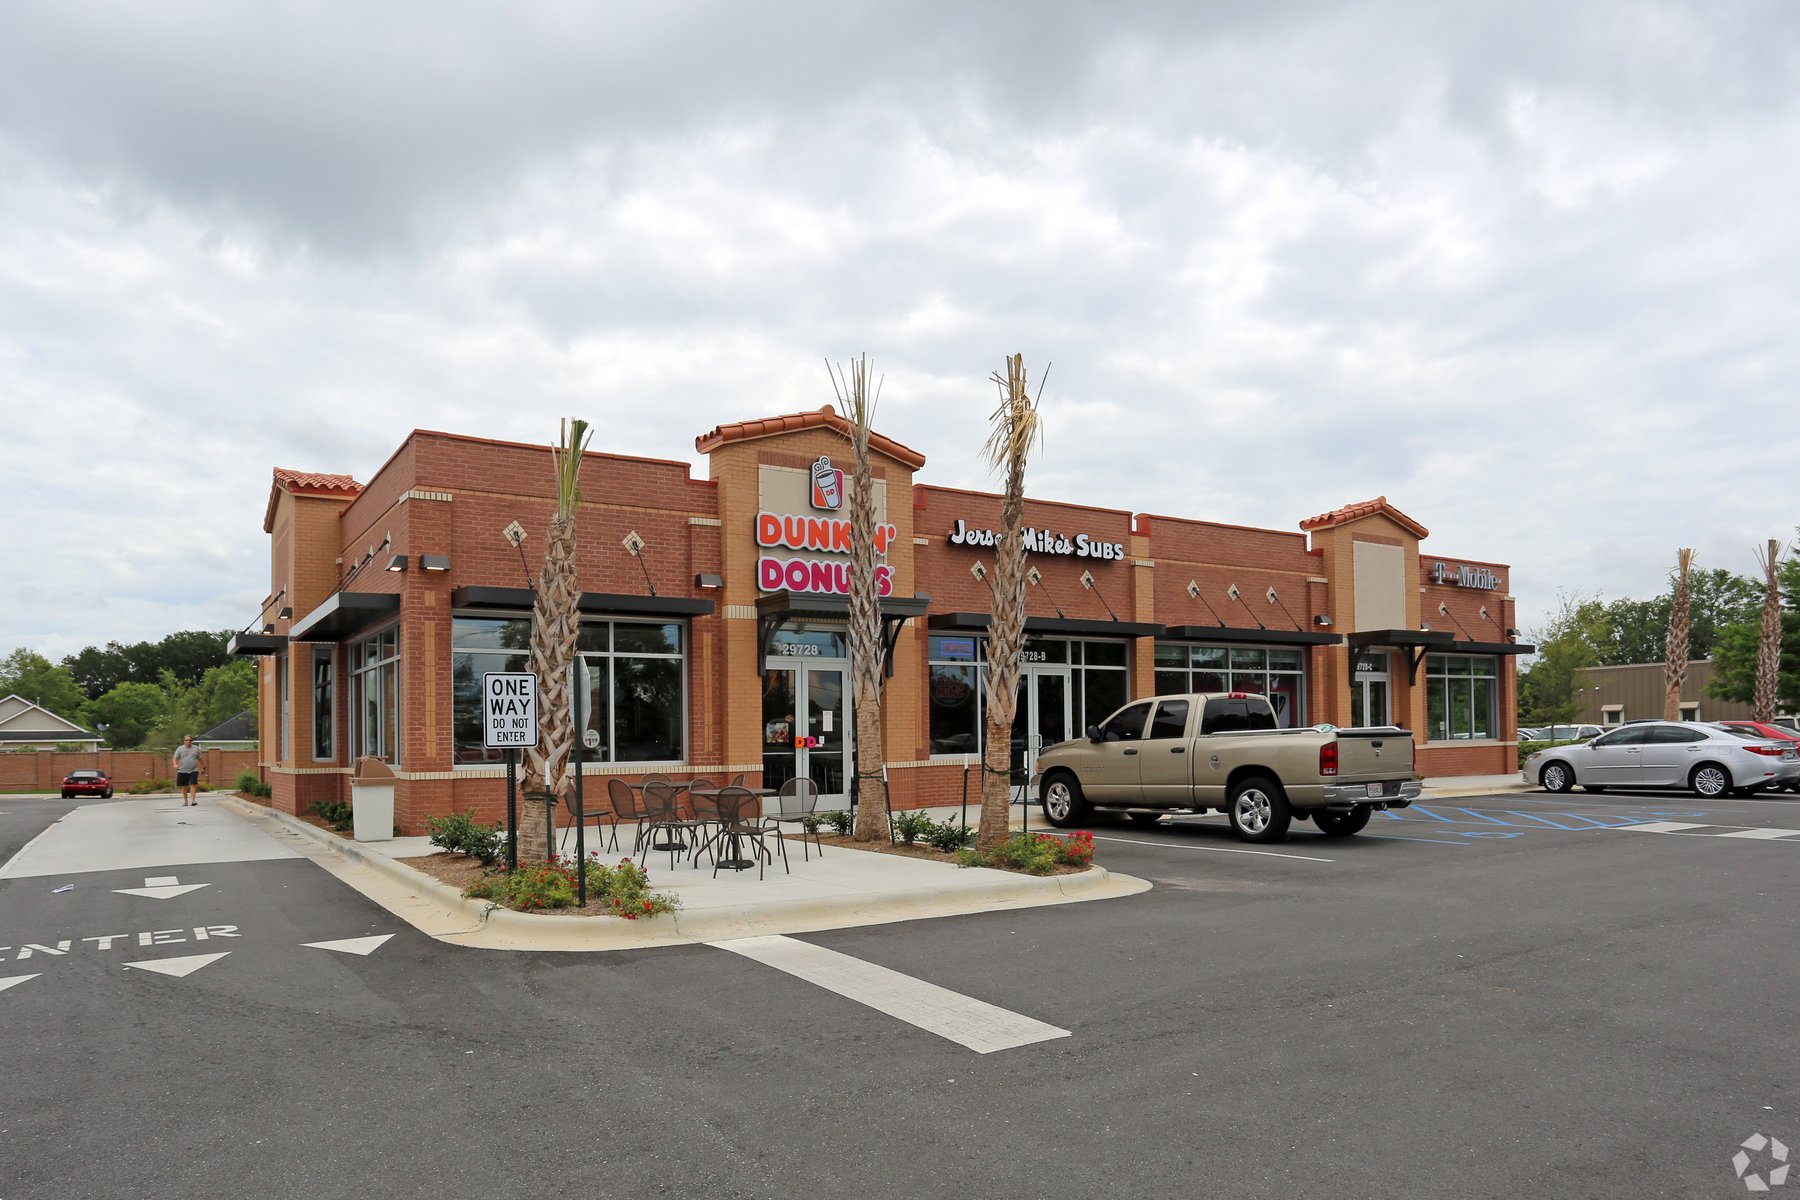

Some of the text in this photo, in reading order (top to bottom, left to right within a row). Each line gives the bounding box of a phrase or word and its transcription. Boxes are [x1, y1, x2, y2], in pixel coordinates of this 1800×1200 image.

[760, 514, 894, 554] DUNKN'
[951, 519, 1004, 546] Jerse
[1076, 533, 1125, 561] SUBS
[761, 559, 891, 596] DONUS
[782, 644, 818, 656] 29728
[492, 678, 530, 696] ONE
[490, 698, 531, 716] WAY
[493, 718, 529, 729] DO NOT
[497, 731, 526, 742] ENTER
